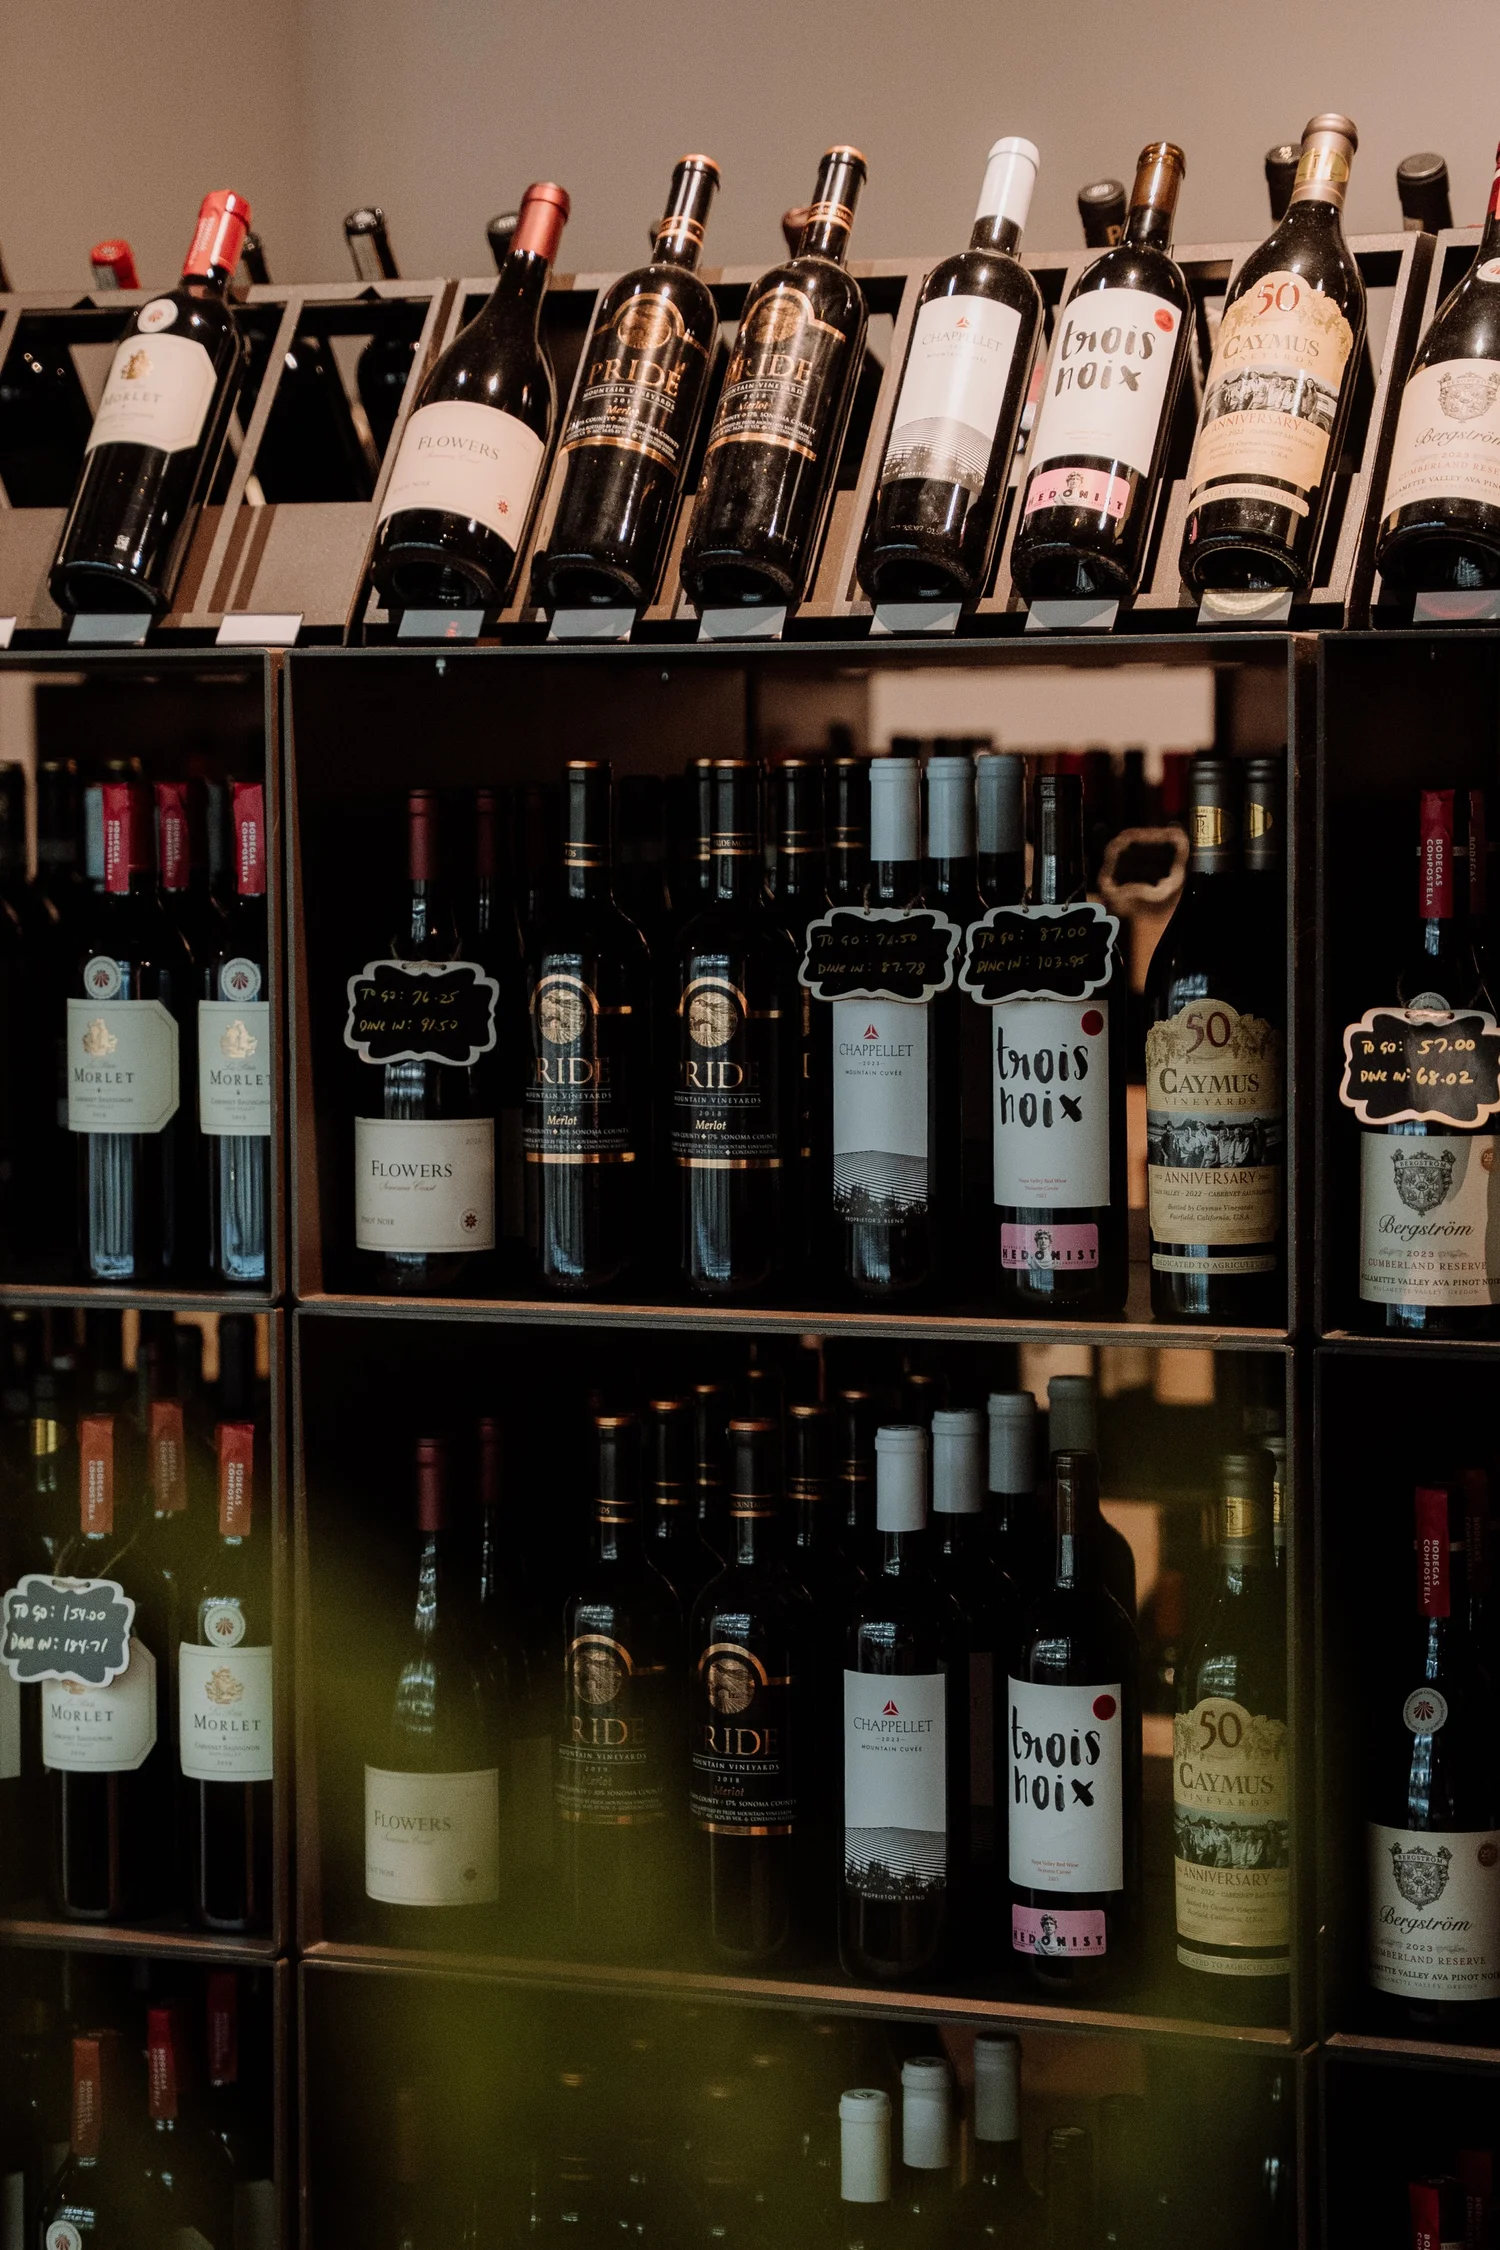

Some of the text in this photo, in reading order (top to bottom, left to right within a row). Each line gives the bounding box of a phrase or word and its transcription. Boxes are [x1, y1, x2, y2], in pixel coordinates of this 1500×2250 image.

[1254, 281, 1300, 318] 50
[1061, 320, 1156, 361] trois
[1223, 334, 1320, 360] CAYMUS
[588, 358, 685, 397] PRIDE
[1054, 360, 1141, 397] noix
[583, 387, 625, 398] MOUNTAIN
[1213, 412, 1302, 430] ANNIVERSARY
[1415, 428, 1500, 447] Bergströ
[417, 435, 500, 461] FLOWERS
[1465, 476, 1481, 484] AVA
[249, 821, 258, 866] BODEGAS
[1435, 839, 1443, 887] BODEGAS
[1426, 839, 1434, 906] COMPOSTELA
[1040, 926, 1087, 942] 87.00
[882, 961, 926, 976] 87.78
[360, 988, 376, 1001] TO
[412, 989, 460, 1006] 76.25
[421, 1017, 458, 1032] 91.50
[1186, 1011, 1231, 1054] 50
[839, 1043, 914, 1057] CHAPPELLET
[996, 1026, 1089, 1084] trois
[1361, 1037, 1476, 1055] TO GO: 57.00
[73, 1066, 136, 1084] MORLET
[1159, 1067, 1260, 1094] CAYMUS
[1416, 1066, 1474, 1086] 68.02
[561, 1092, 612, 1100] VINEYARDS
[711, 1096, 761, 1104] VINEYARDS
[1164, 1097, 1257, 1105] VINEYARDS
[1000, 1086, 1083, 1128] noix
[547, 1115, 578, 1125] Merlot
[695, 1119, 727, 1130] Merlot
[371, 1159, 453, 1178] FLOWERS
[1399, 1160, 1447, 1168] BERGSTRÖM
[1164, 1171, 1257, 1185] ANNIVERSARY
[1188, 1204, 1195, 1212] by
[1378, 1213, 1474, 1243] Bergström
[1002, 1248, 1097, 1261] HEDONIST
[1406, 1250, 1435, 1258] 2023
[1197, 1261, 1210, 1269] TO
[1368, 1258, 1487, 1271] CUMBERLAND RESERVE
[1398, 1277, 1430, 1286] VALLEY
[1432, 1279, 1450, 1287] AVA
[226, 1461, 235, 1523] COMPOSTELA
[235, 1462, 244, 1506] BODEGAS
[1423, 1538, 1431, 1605] COMPOSTELA
[1432, 1539, 1440, 1586] BODEGAS
[13, 1602, 29, 1619] TO
[63, 1603, 106, 1622] 154.00
[64, 1637, 109, 1655] 184.71
[51, 1703, 114, 1722] MORLET
[193, 1713, 262, 1731] MORLET
[853, 1716, 933, 1733] CHAPPELLET
[1200, 1711, 1242, 1750] 50
[1011, 1704, 1100, 1767] trois
[861, 1744, 922, 1752] MOUNTAIN CUVÉE
[693, 1757, 780, 1771] MOUNTAIN VINEYARDS
[1179, 1762, 1274, 1795] CAYMUS
[713, 1785, 745, 1797] Merlot
[1014, 1765, 1094, 1812] noix
[374, 1810, 451, 1832] FLOWERS
[1398, 1855, 1443, 1864] BERGSTRÖM
[1183, 1866, 1271, 1886] ANNIVERSARY
[1200, 1887, 1215, 1896] 2022
[1380, 1905, 1473, 1934] Bergström
[1406, 1943, 1433, 1952] 2023
[1438, 1956, 1486, 1966] RESERVE
[1398, 1969, 1479, 1981] VALLEY AVA PINOT
